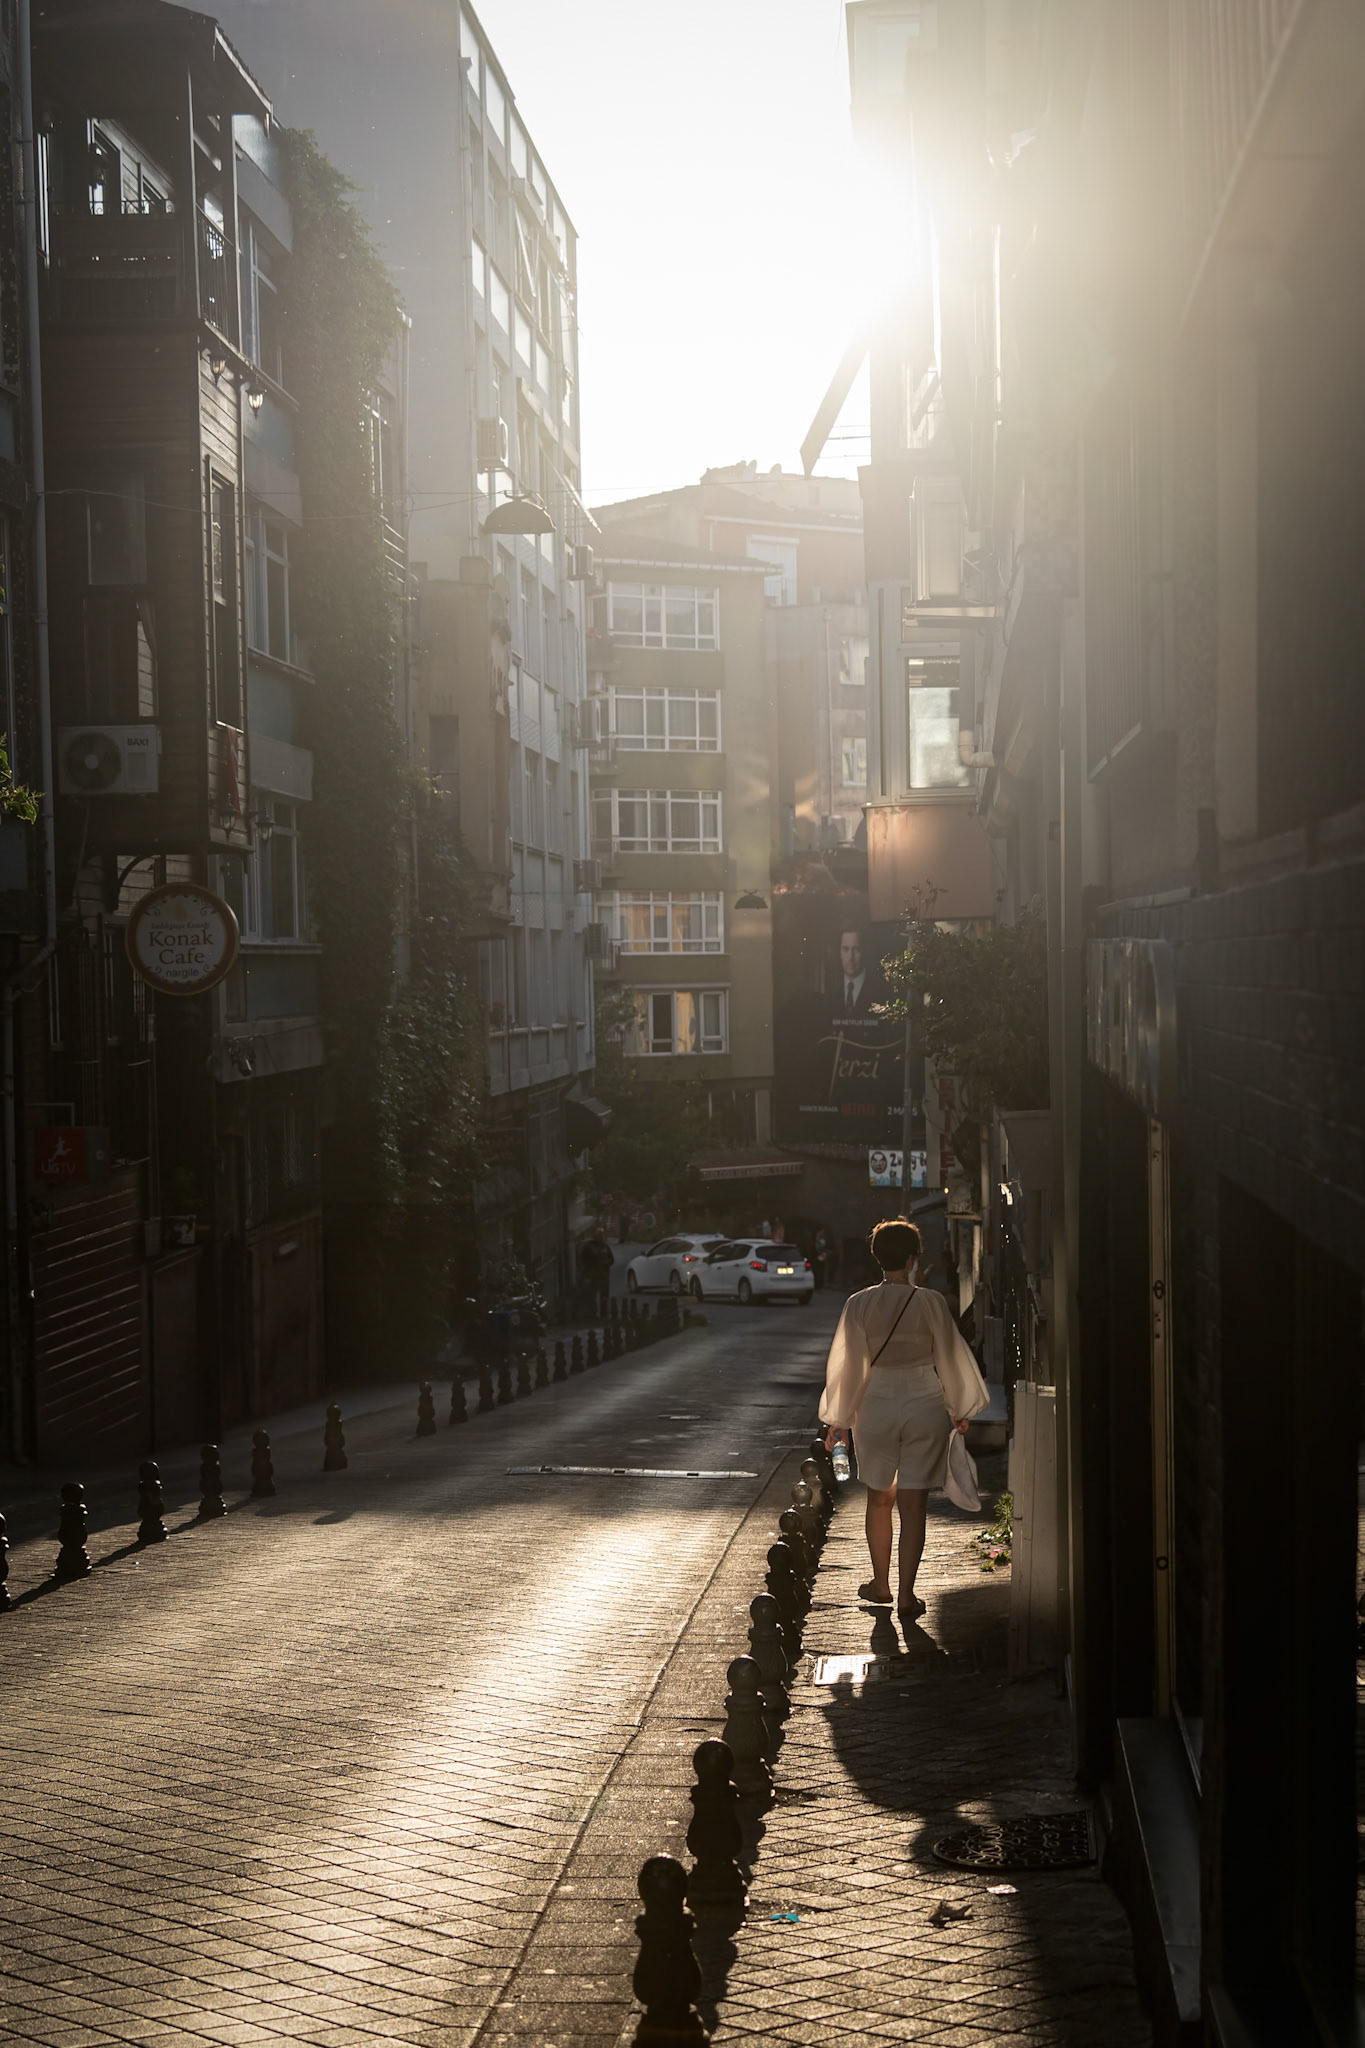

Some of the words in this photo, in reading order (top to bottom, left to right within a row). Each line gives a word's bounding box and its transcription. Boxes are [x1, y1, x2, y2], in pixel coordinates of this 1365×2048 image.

[128, 738, 149, 746] BAXI
[149, 930, 214, 947] Konak
[160, 948, 205, 965] Cafe
[166, 968, 200, 979] nargile
